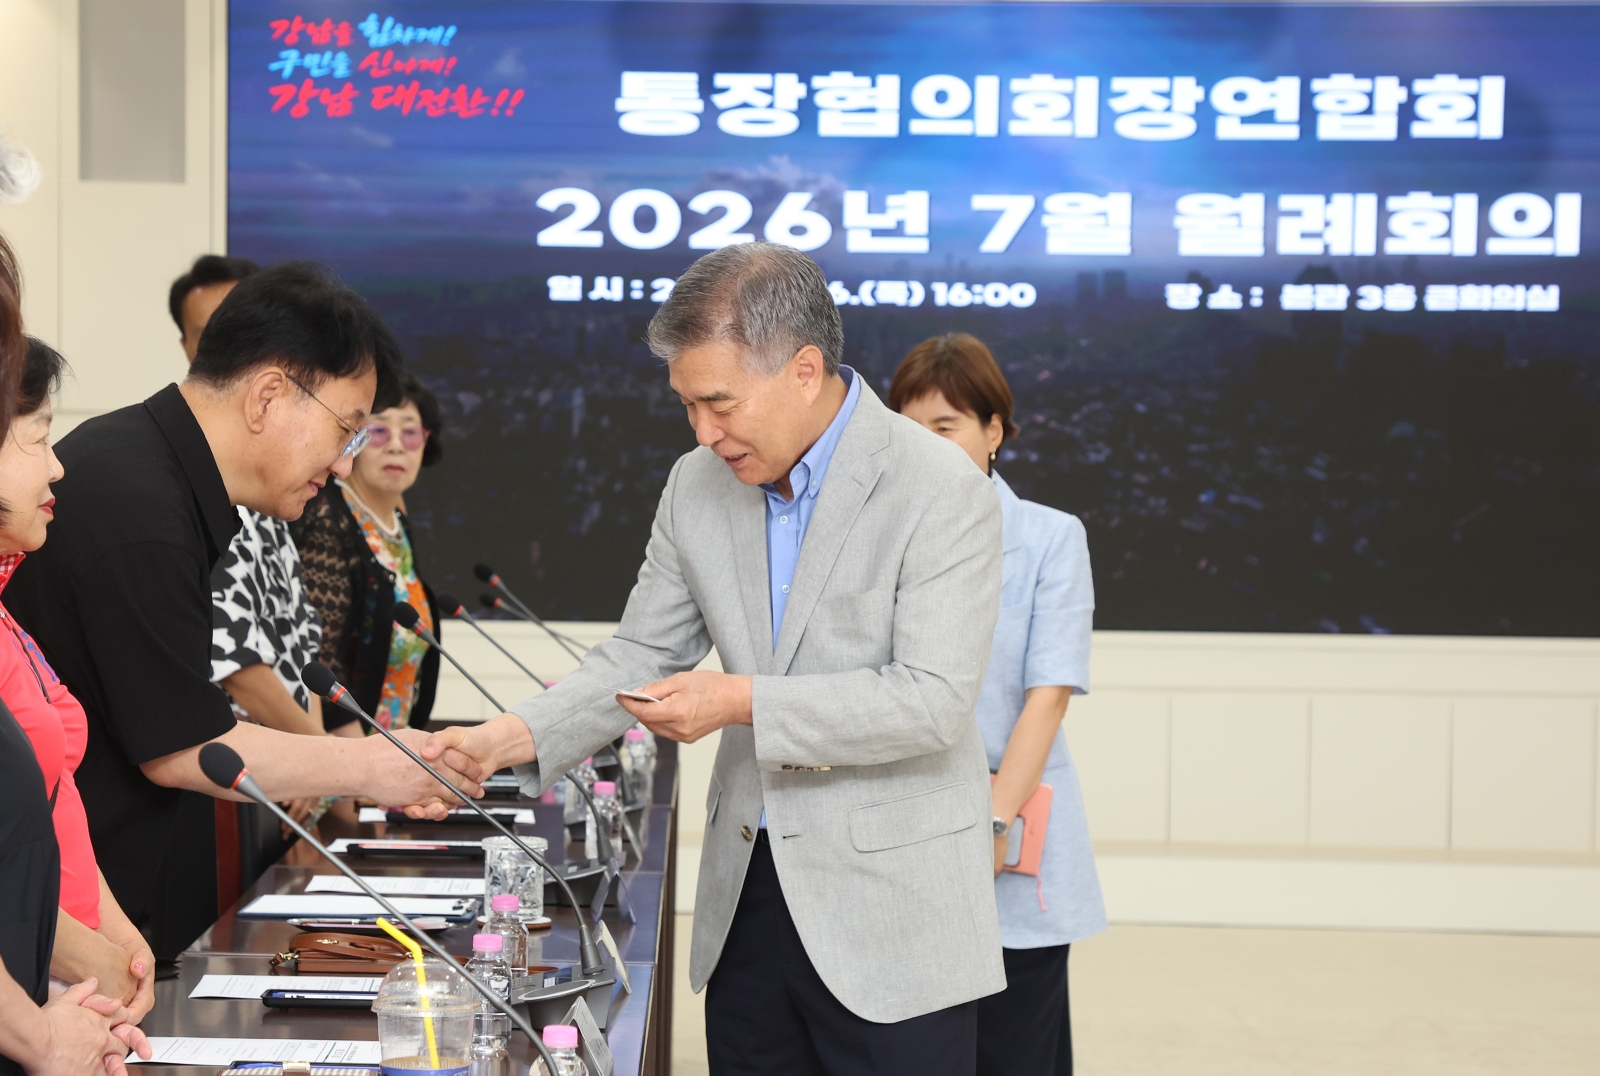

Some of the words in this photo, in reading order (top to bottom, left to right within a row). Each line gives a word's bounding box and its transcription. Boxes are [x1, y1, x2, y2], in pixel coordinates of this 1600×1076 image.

[269, 15, 353, 47] 강남을
[268, 48, 352, 80] 구민을
[269, 78, 359, 118] 강남
[370, 80, 525, 118] 대전환!!
[614, 70, 1506, 141] 통장협의회장연합회
[535, 187, 931, 254] 2026년
[970, 191, 1133, 256] 7월
[1172, 191, 1582, 257] 월례회의
[931, 281, 1037, 308] 16:00
[1356, 283, 1418, 312] 3층
